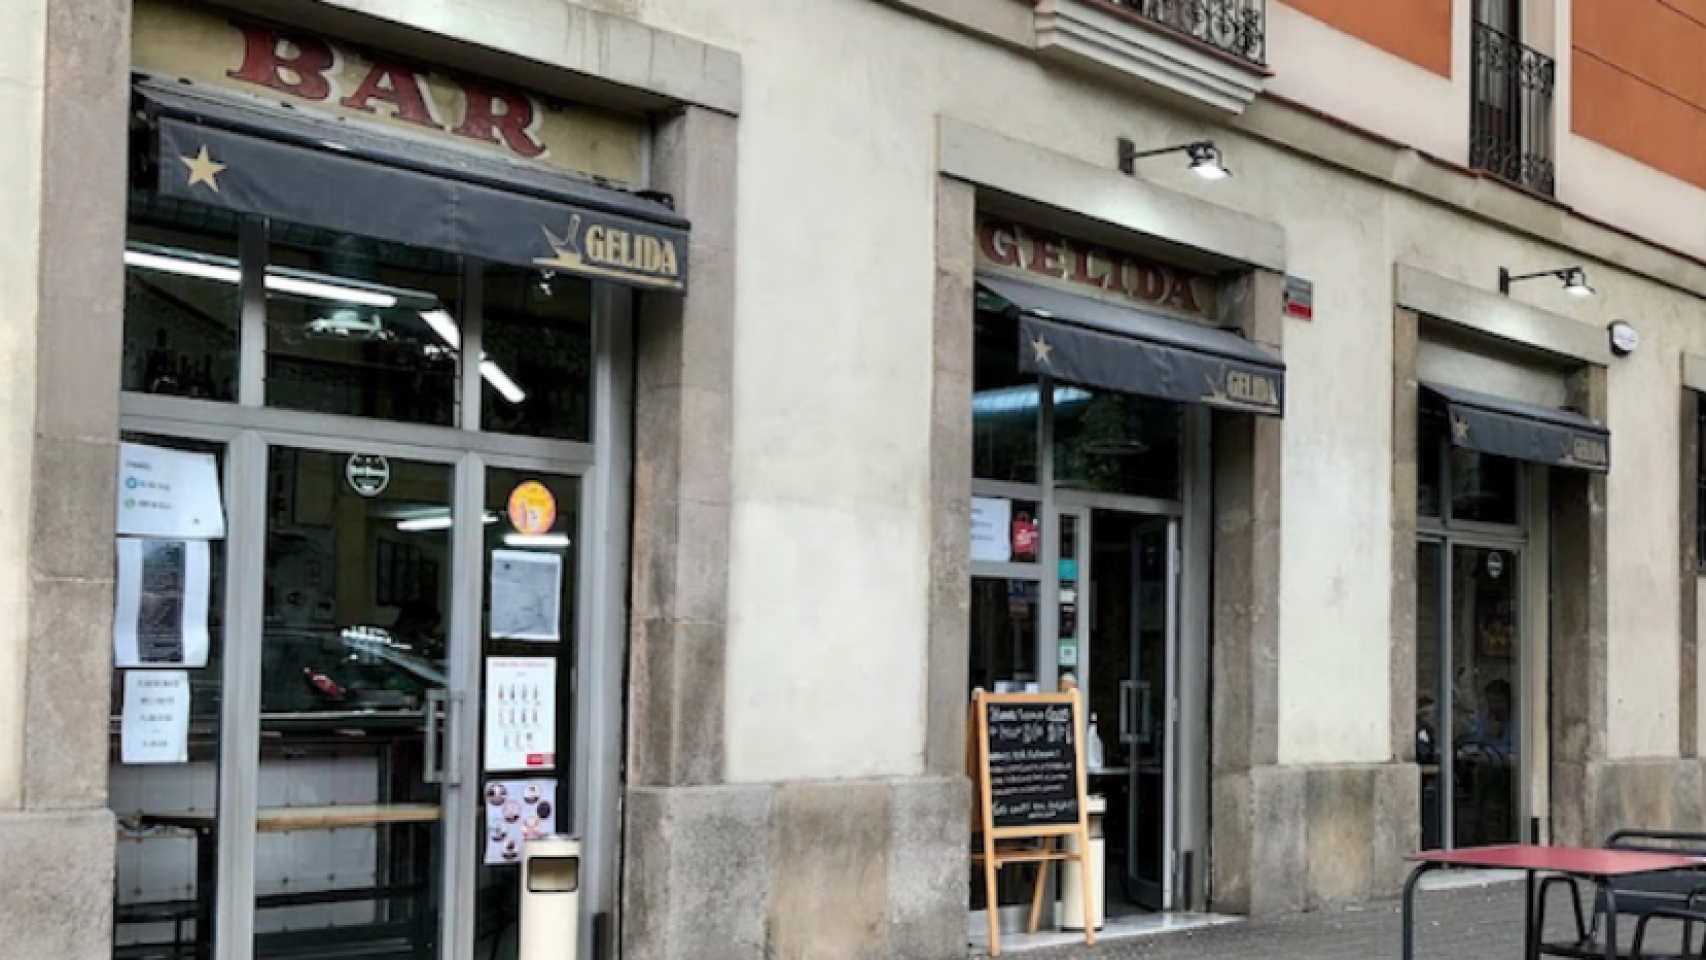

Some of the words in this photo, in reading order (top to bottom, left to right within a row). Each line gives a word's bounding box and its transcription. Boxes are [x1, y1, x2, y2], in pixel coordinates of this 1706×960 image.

[226, 21, 546, 158] BAR
[586, 224, 677, 276] GELIDA
[979, 219, 1200, 310] GELIDA
[1226, 371, 1278, 405] GELIDA
